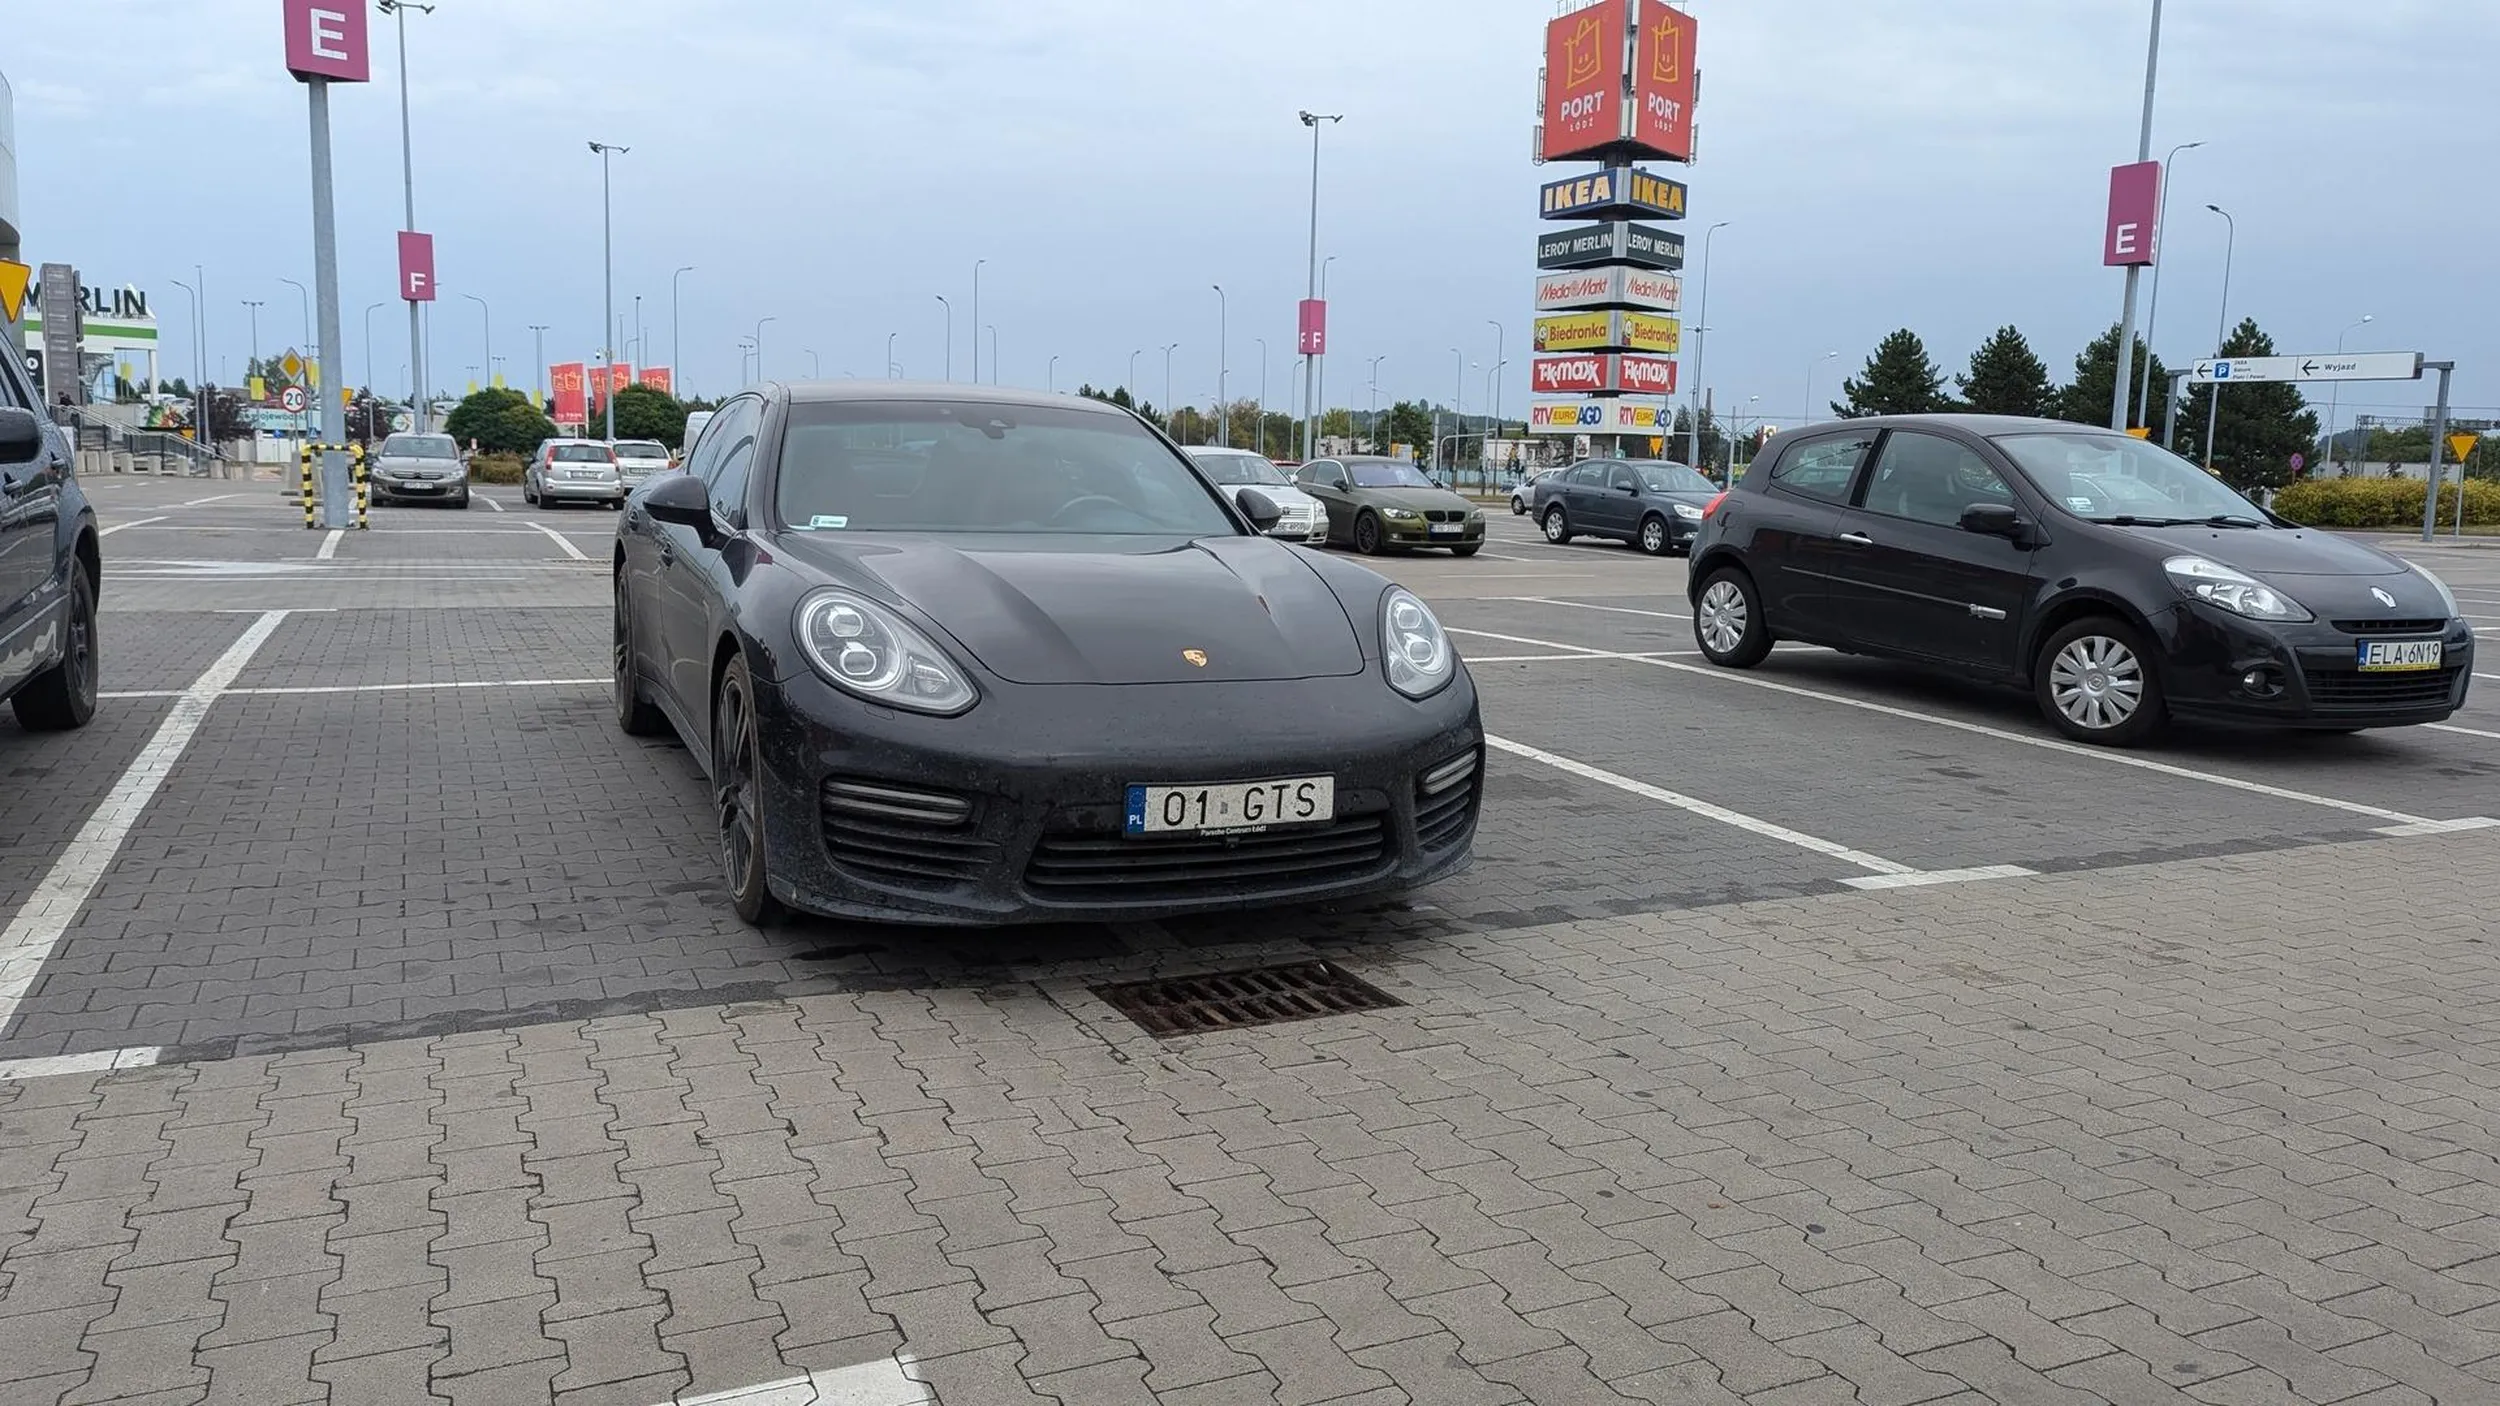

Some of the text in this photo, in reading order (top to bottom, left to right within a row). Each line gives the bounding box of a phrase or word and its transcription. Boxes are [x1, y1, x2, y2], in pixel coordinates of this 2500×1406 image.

[310, 8, 348, 61] E
[1561, 91, 1605, 121] PORT
[1648, 92, 1681, 122] PORT
[1544, 176, 1612, 212] IKEA
[1632, 175, 1684, 212] IKEA
[1539, 233, 1613, 259] LEROY MERLIN
[1627, 235, 1683, 259] LEROY MERLIN
[2115, 222, 2138, 254] E
[410, 272, 426, 292] F
[1312, 332, 1322, 348] F
[1549, 325, 1607, 342] Biedronka
[1634, 323, 1677, 344] Biedronka
[2324, 363, 2357, 371] Wyjazd
[286, 392, 304, 406] 20
[1532, 406, 1602, 425] RTV EURO AGD
[1619, 406, 1672, 428] RTV EURO AGD
[2369, 642, 2440, 665] ELA 6N19
[1243, 782, 1316, 822] GTS
[1129, 814, 1143, 826] PL
